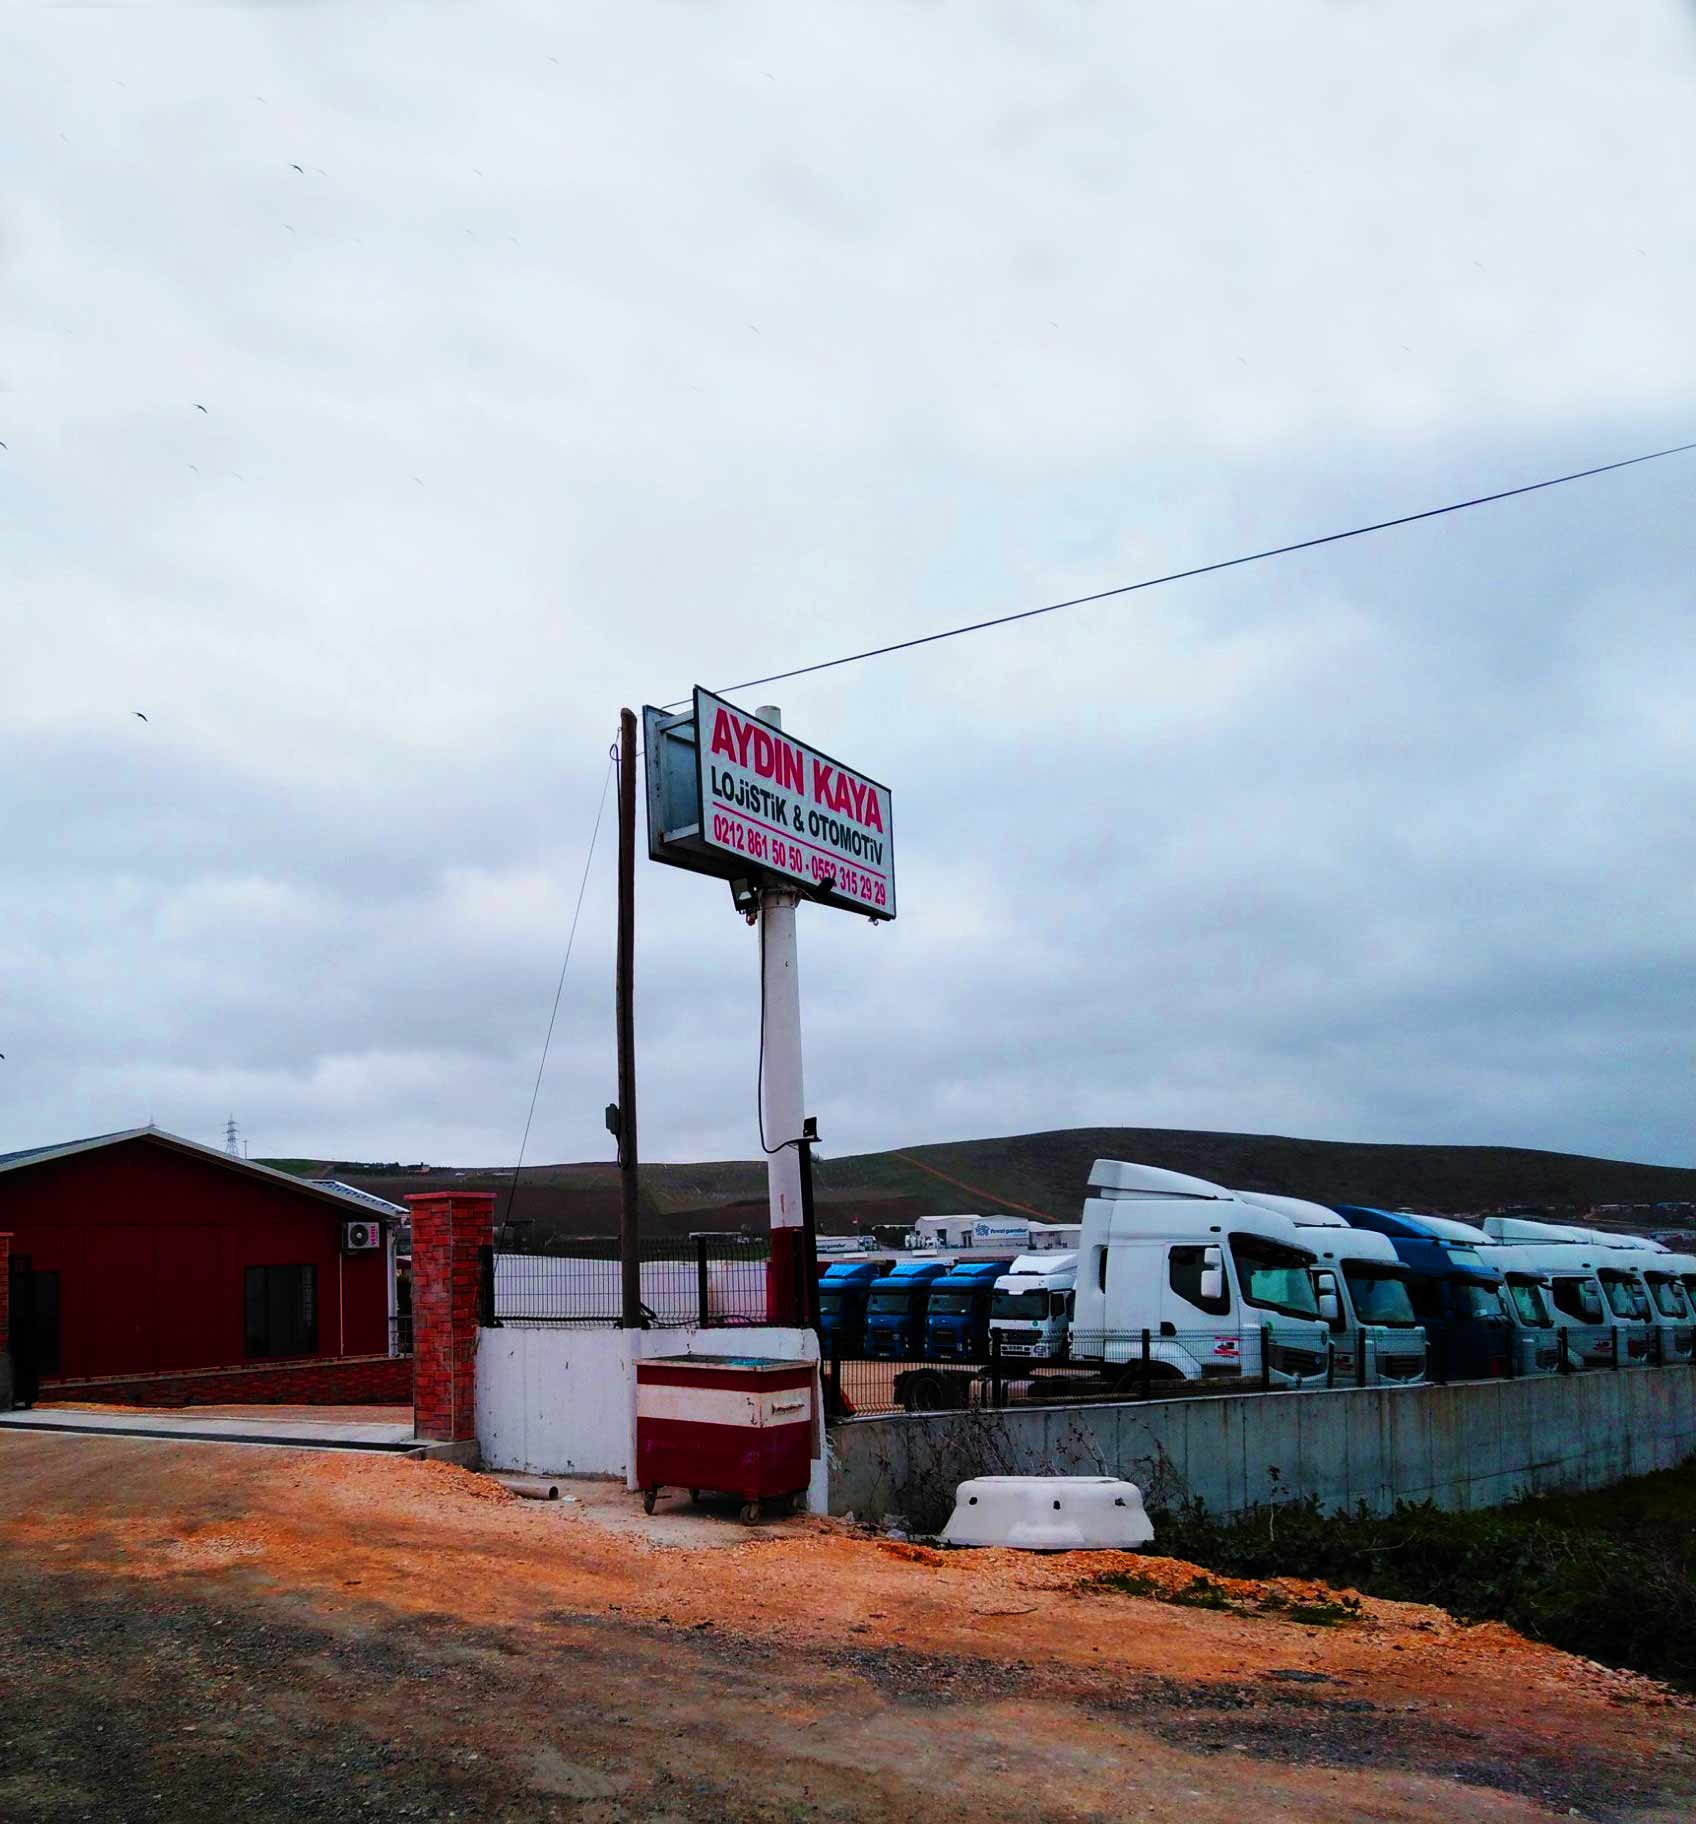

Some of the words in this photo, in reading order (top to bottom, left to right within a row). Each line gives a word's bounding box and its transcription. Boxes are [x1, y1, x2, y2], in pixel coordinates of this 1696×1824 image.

[712, 707, 804, 796] AYDIN
[813, 759, 883, 834] KAYA
[713, 814, 744, 850] 0212
[748, 828, 767, 858] 861
[772, 839, 786, 867] 50
[789, 847, 802, 873] 50
[840, 867, 857, 895] 315
[860, 876, 872, 900] 29
[875, 881, 886, 906] 29
[793, 805, 805, 832] &
